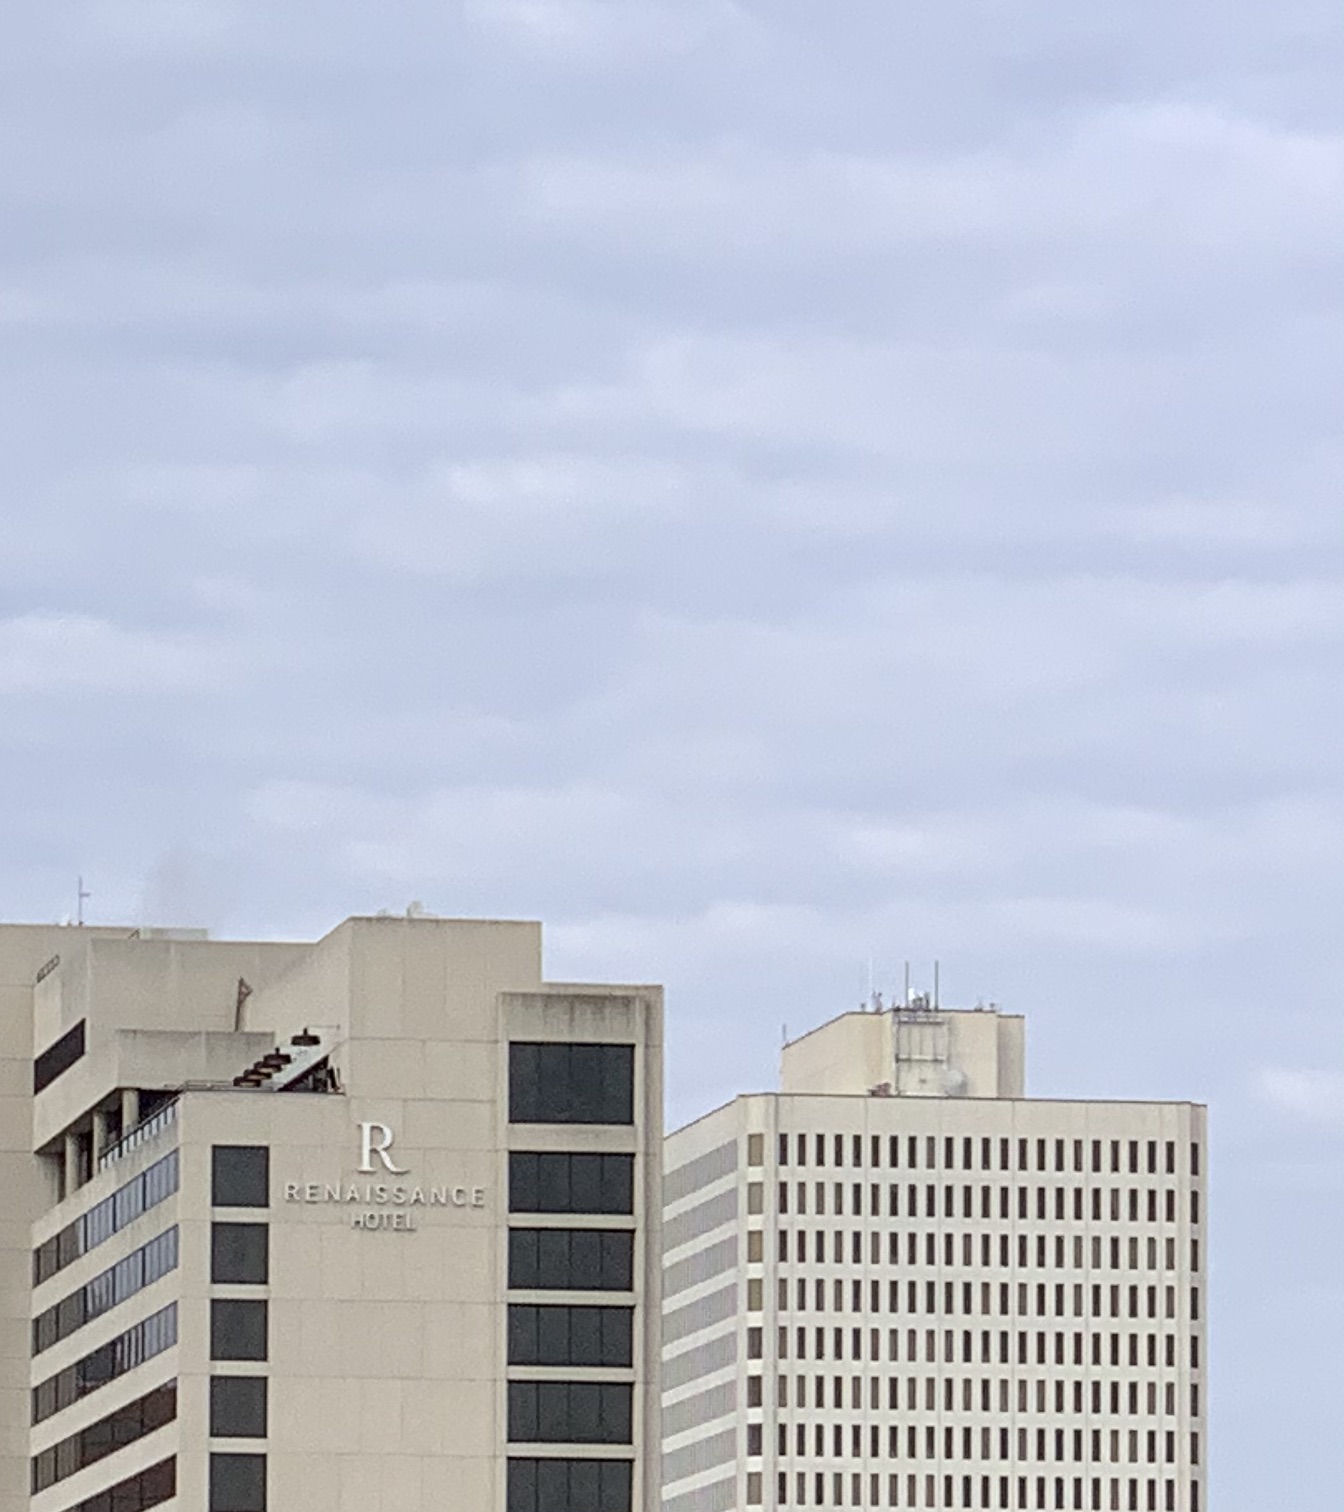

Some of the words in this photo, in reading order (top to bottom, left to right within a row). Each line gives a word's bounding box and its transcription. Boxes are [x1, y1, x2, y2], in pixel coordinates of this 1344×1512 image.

[356, 1121, 410, 1175] R
[283, 1182, 486, 1208] RENAISSANCE
[351, 1211, 417, 1232] HOTEL
